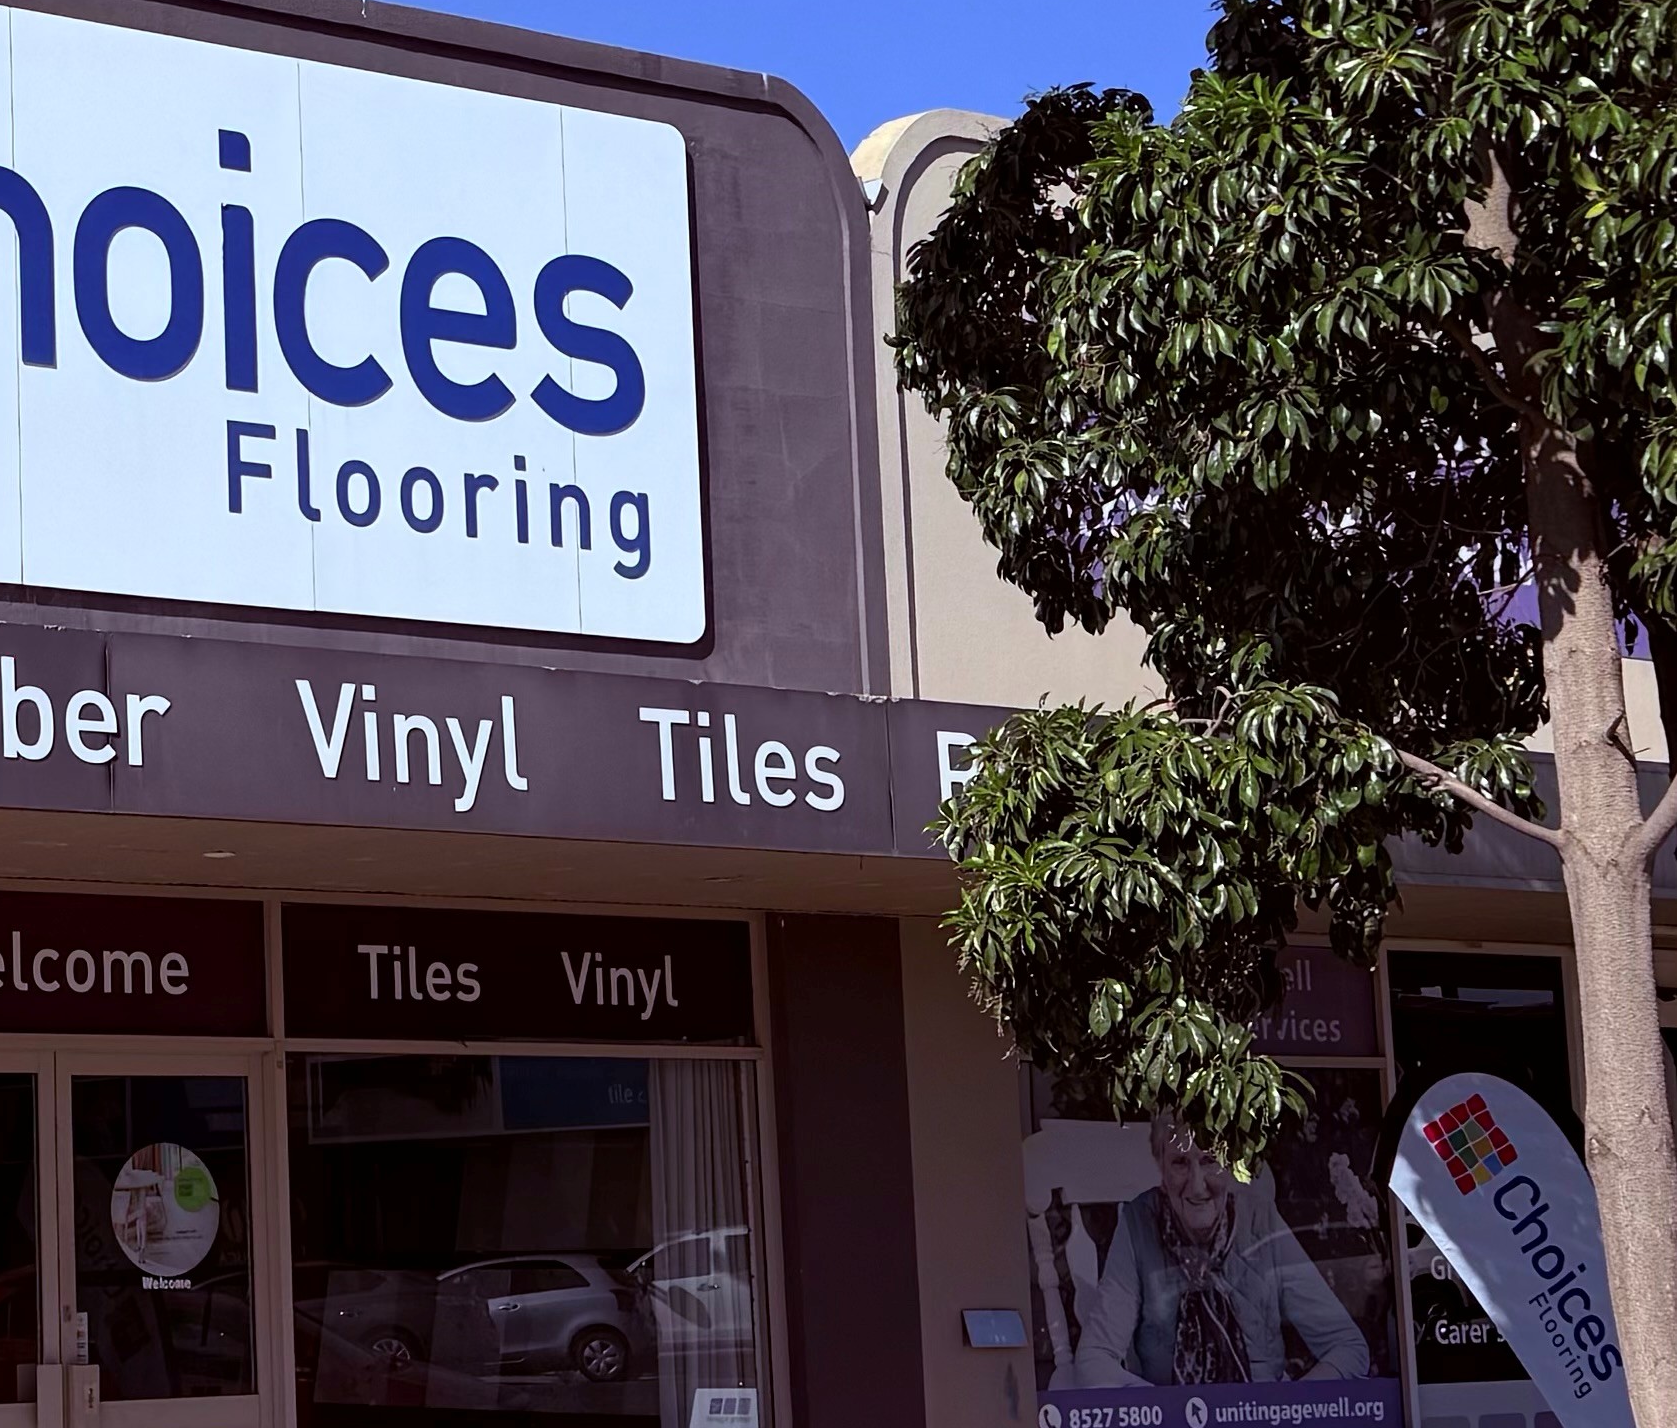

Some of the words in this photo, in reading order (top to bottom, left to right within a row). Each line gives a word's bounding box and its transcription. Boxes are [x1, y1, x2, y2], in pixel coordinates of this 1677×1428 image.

[226, 419, 651, 580] Flooring
[294, 678, 529, 813] Vinyl
[638, 706, 847, 812] Tiles
[357, 944, 481, 1003] Tiles
[560, 951, 679, 1020] Vinyl
[1252, 1009, 1342, 1043] rvices
[142, 1276, 192, 1290] Welcome
[1493, 1175, 1623, 1382] Choices
[1529, 1291, 1593, 1399] Flooring
[1118, 1405, 1163, 1428] 5800
[1215, 1396, 1385, 1426] unitingagewell.org
